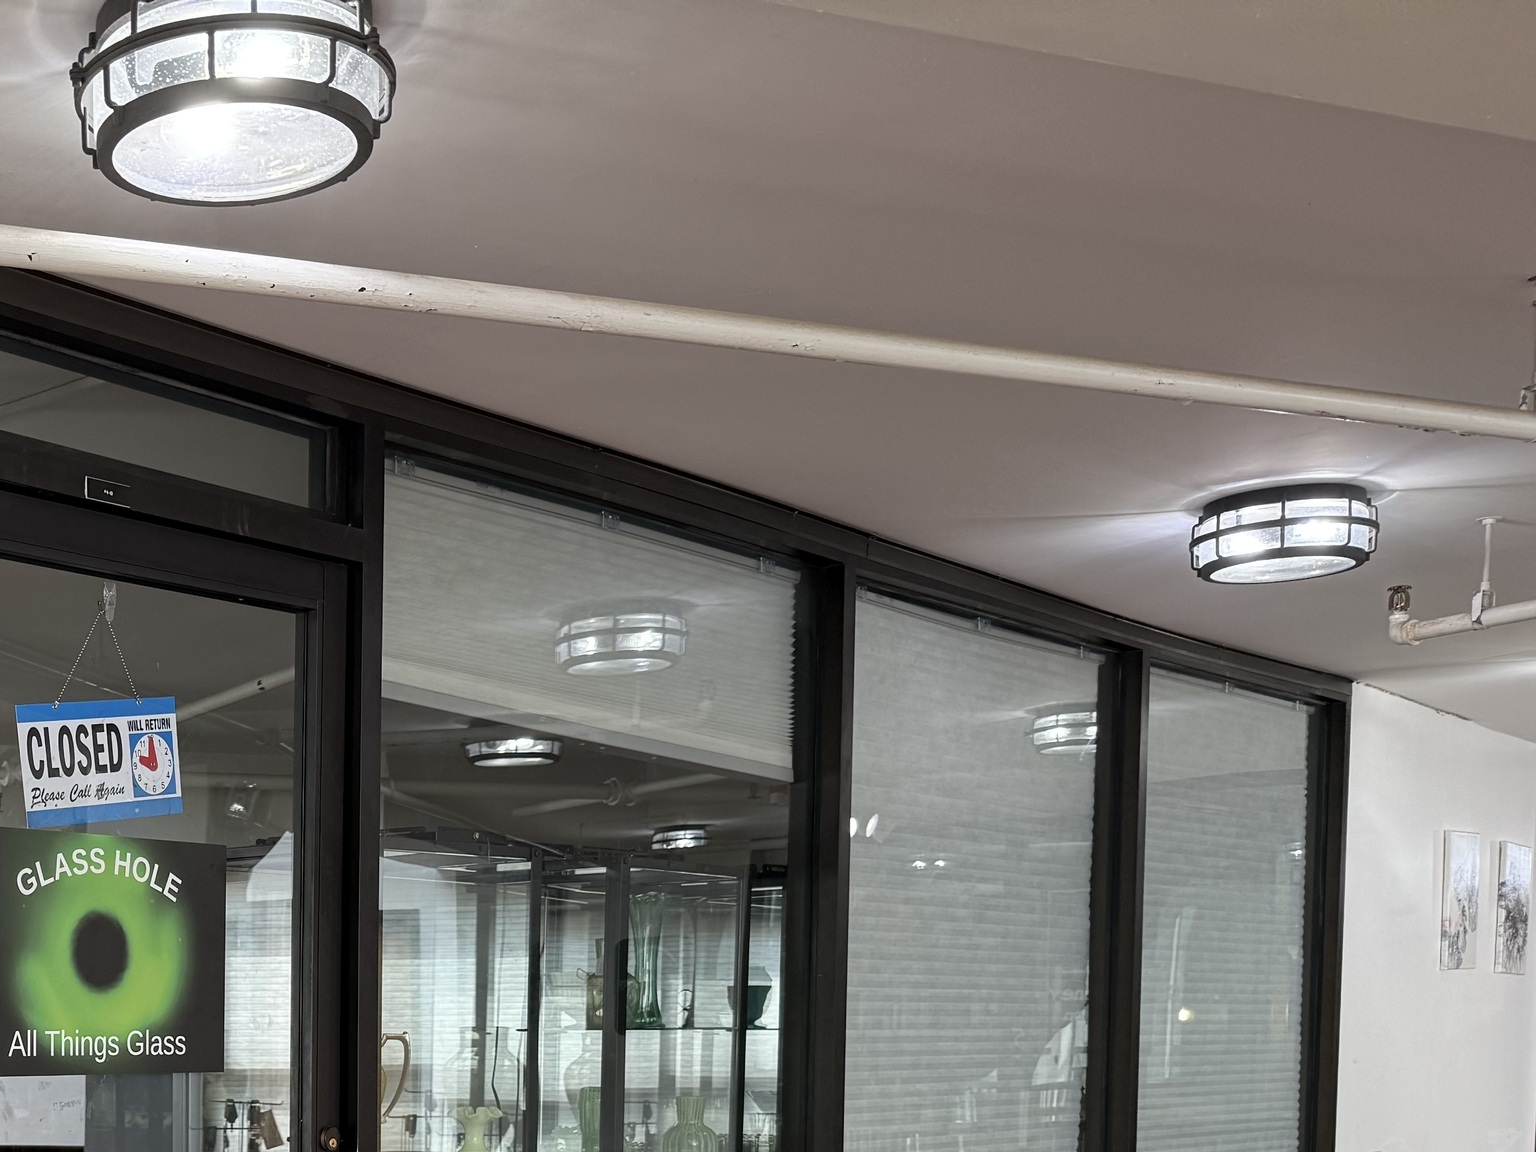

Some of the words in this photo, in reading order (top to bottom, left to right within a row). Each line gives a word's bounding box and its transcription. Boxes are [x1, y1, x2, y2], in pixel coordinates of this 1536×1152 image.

[127, 719, 144, 732] WILL
[145, 718, 171, 731] RETURN
[139, 740, 146, 748] 11
[158, 739, 162, 747] 1
[26, 723, 123, 780] CLOSED
[135, 749, 141, 758] 10
[164, 747, 169, 756] 2
[132, 762, 138, 770] 9
[167, 759, 172, 767] 3
[137, 773, 142, 782] 8
[152, 785, 157, 793] 6
[161, 781, 166, 789] 5
[30, 787, 65, 809] Please
[69, 783, 92, 802] Call
[94, 781, 125, 801] Again
[16, 847, 106, 897] GLASS
[114, 850, 182, 902] HOLE
[8, 1030, 37, 1057] All
[45, 1030, 120, 1063] Things
[126, 1030, 186, 1056] Glass
